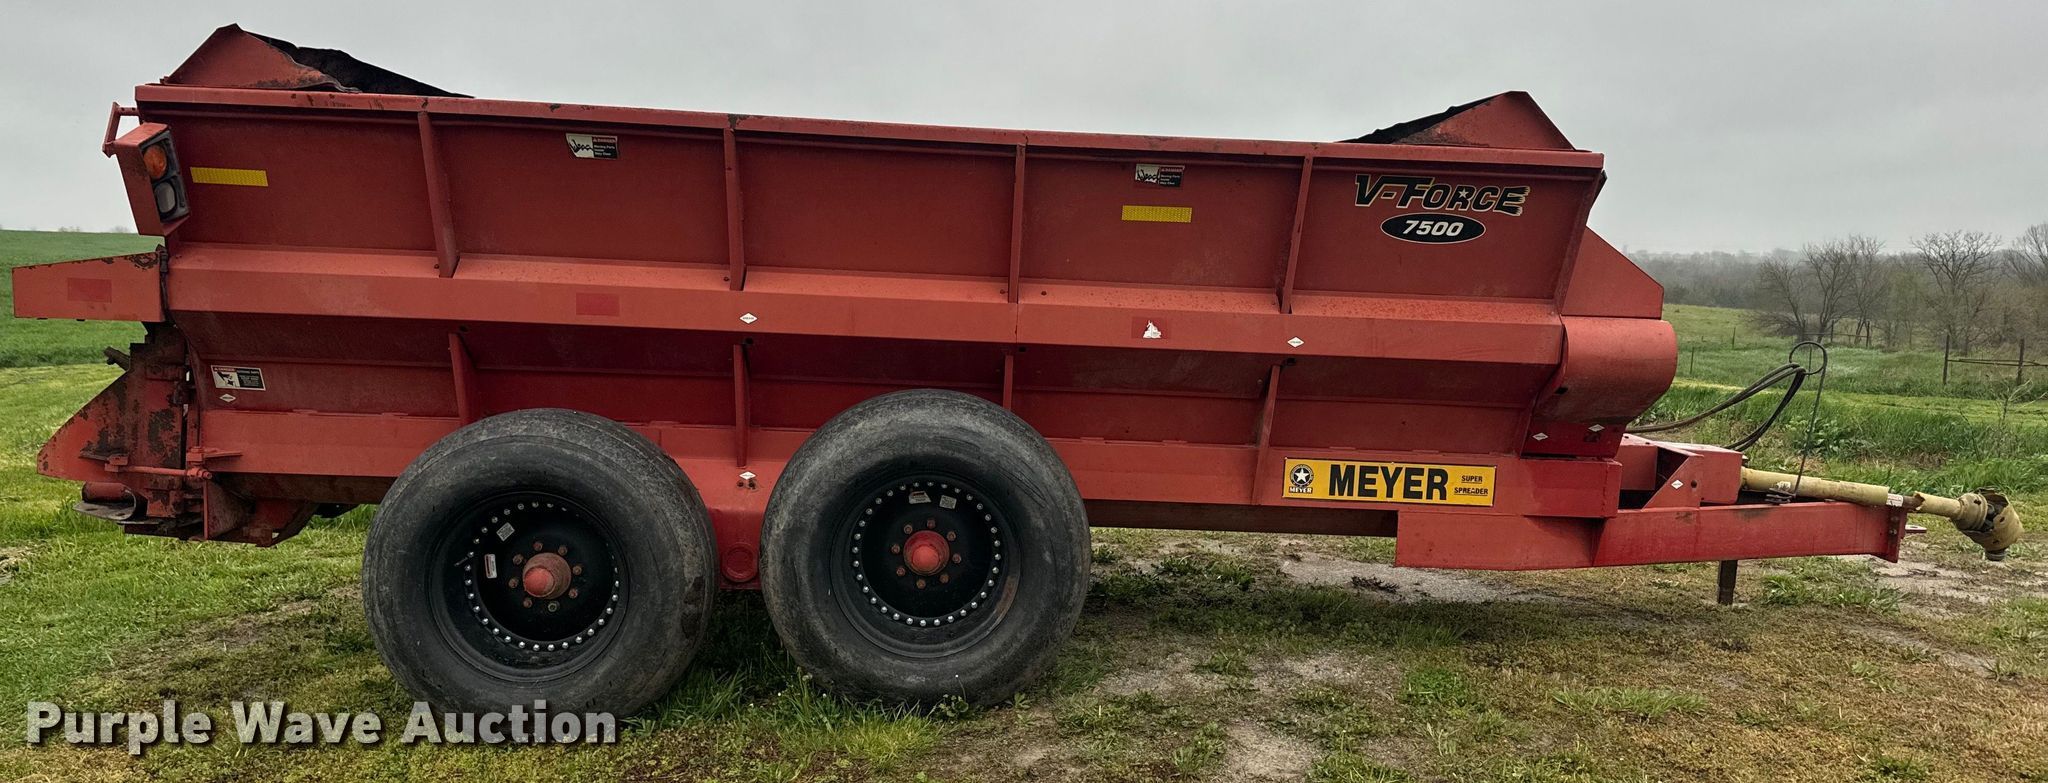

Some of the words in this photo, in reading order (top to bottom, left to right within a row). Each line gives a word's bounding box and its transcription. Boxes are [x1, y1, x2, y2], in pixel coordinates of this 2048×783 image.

[1355, 174, 1531, 216] V-FORCE
[1403, 220, 1464, 237] 7500
[1328, 464, 1449, 501] MEYER
[1461, 474, 1483, 482] SUPER
[1454, 487, 1489, 495] SPREADER
